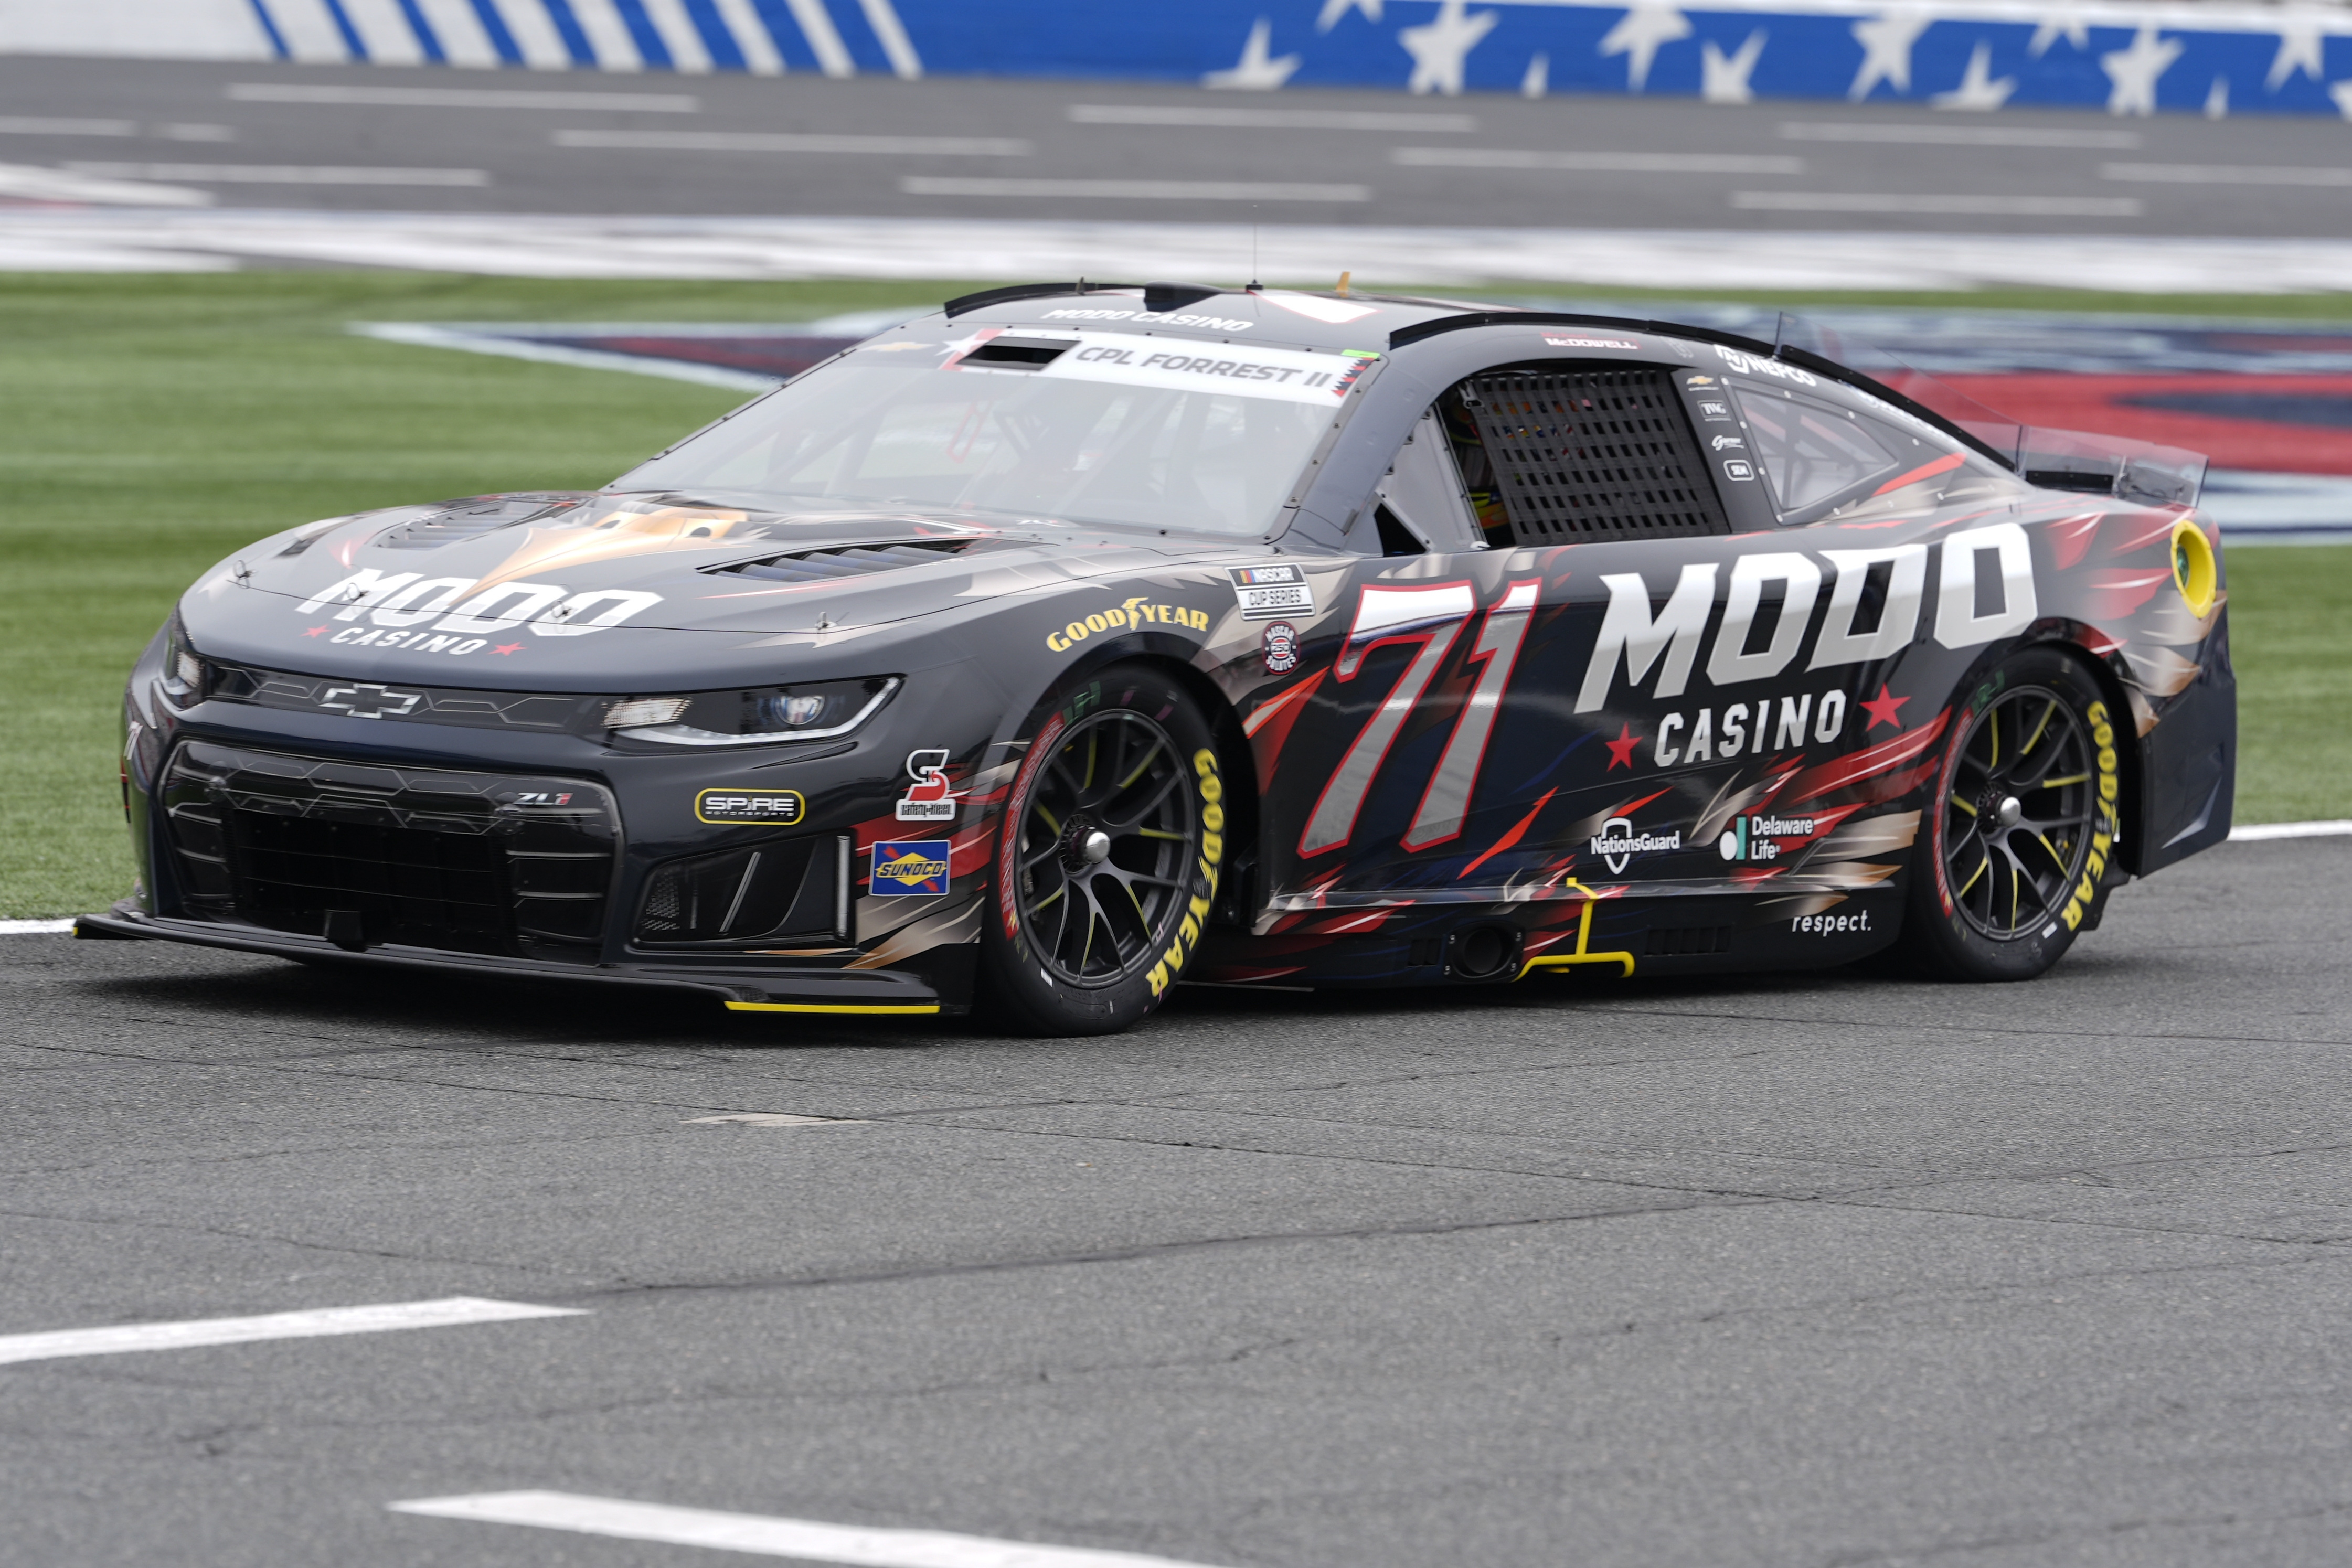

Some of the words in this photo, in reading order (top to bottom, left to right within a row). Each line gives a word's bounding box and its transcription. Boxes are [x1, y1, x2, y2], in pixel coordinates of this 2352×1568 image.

[1040, 308, 1136, 321] MODO
[1130, 311, 1254, 332] CASINO
[1076, 347, 1139, 365] CPL
[1142, 353, 1304, 383] FORREST
[1303, 371, 1333, 387] II
[1744, 355, 1817, 387] NEFCO
[1252, 567, 1295, 583] NASCAR
[294, 568, 665, 636] MODO
[1249, 591, 1267, 606] CUP
[1269, 589, 1302, 605] SERIES
[1046, 598, 1209, 652] GOODYEAR
[1573, 523, 2038, 714] MODO
[329, 627, 488, 656] CASINO
[1296, 577, 1542, 860] 71
[1654, 688, 1847, 768] CASINO
[513, 792, 574, 805] ZL1
[1751, 815, 1814, 836] Delaware
[2061, 700, 2118, 932] GOODYEAR
[1590, 830, 1680, 855] NationsGuard
[880, 862, 944, 876] SUNOCO
[1145, 746, 1225, 997] GOODYEAR
[1792, 910, 1872, 937] respect.
